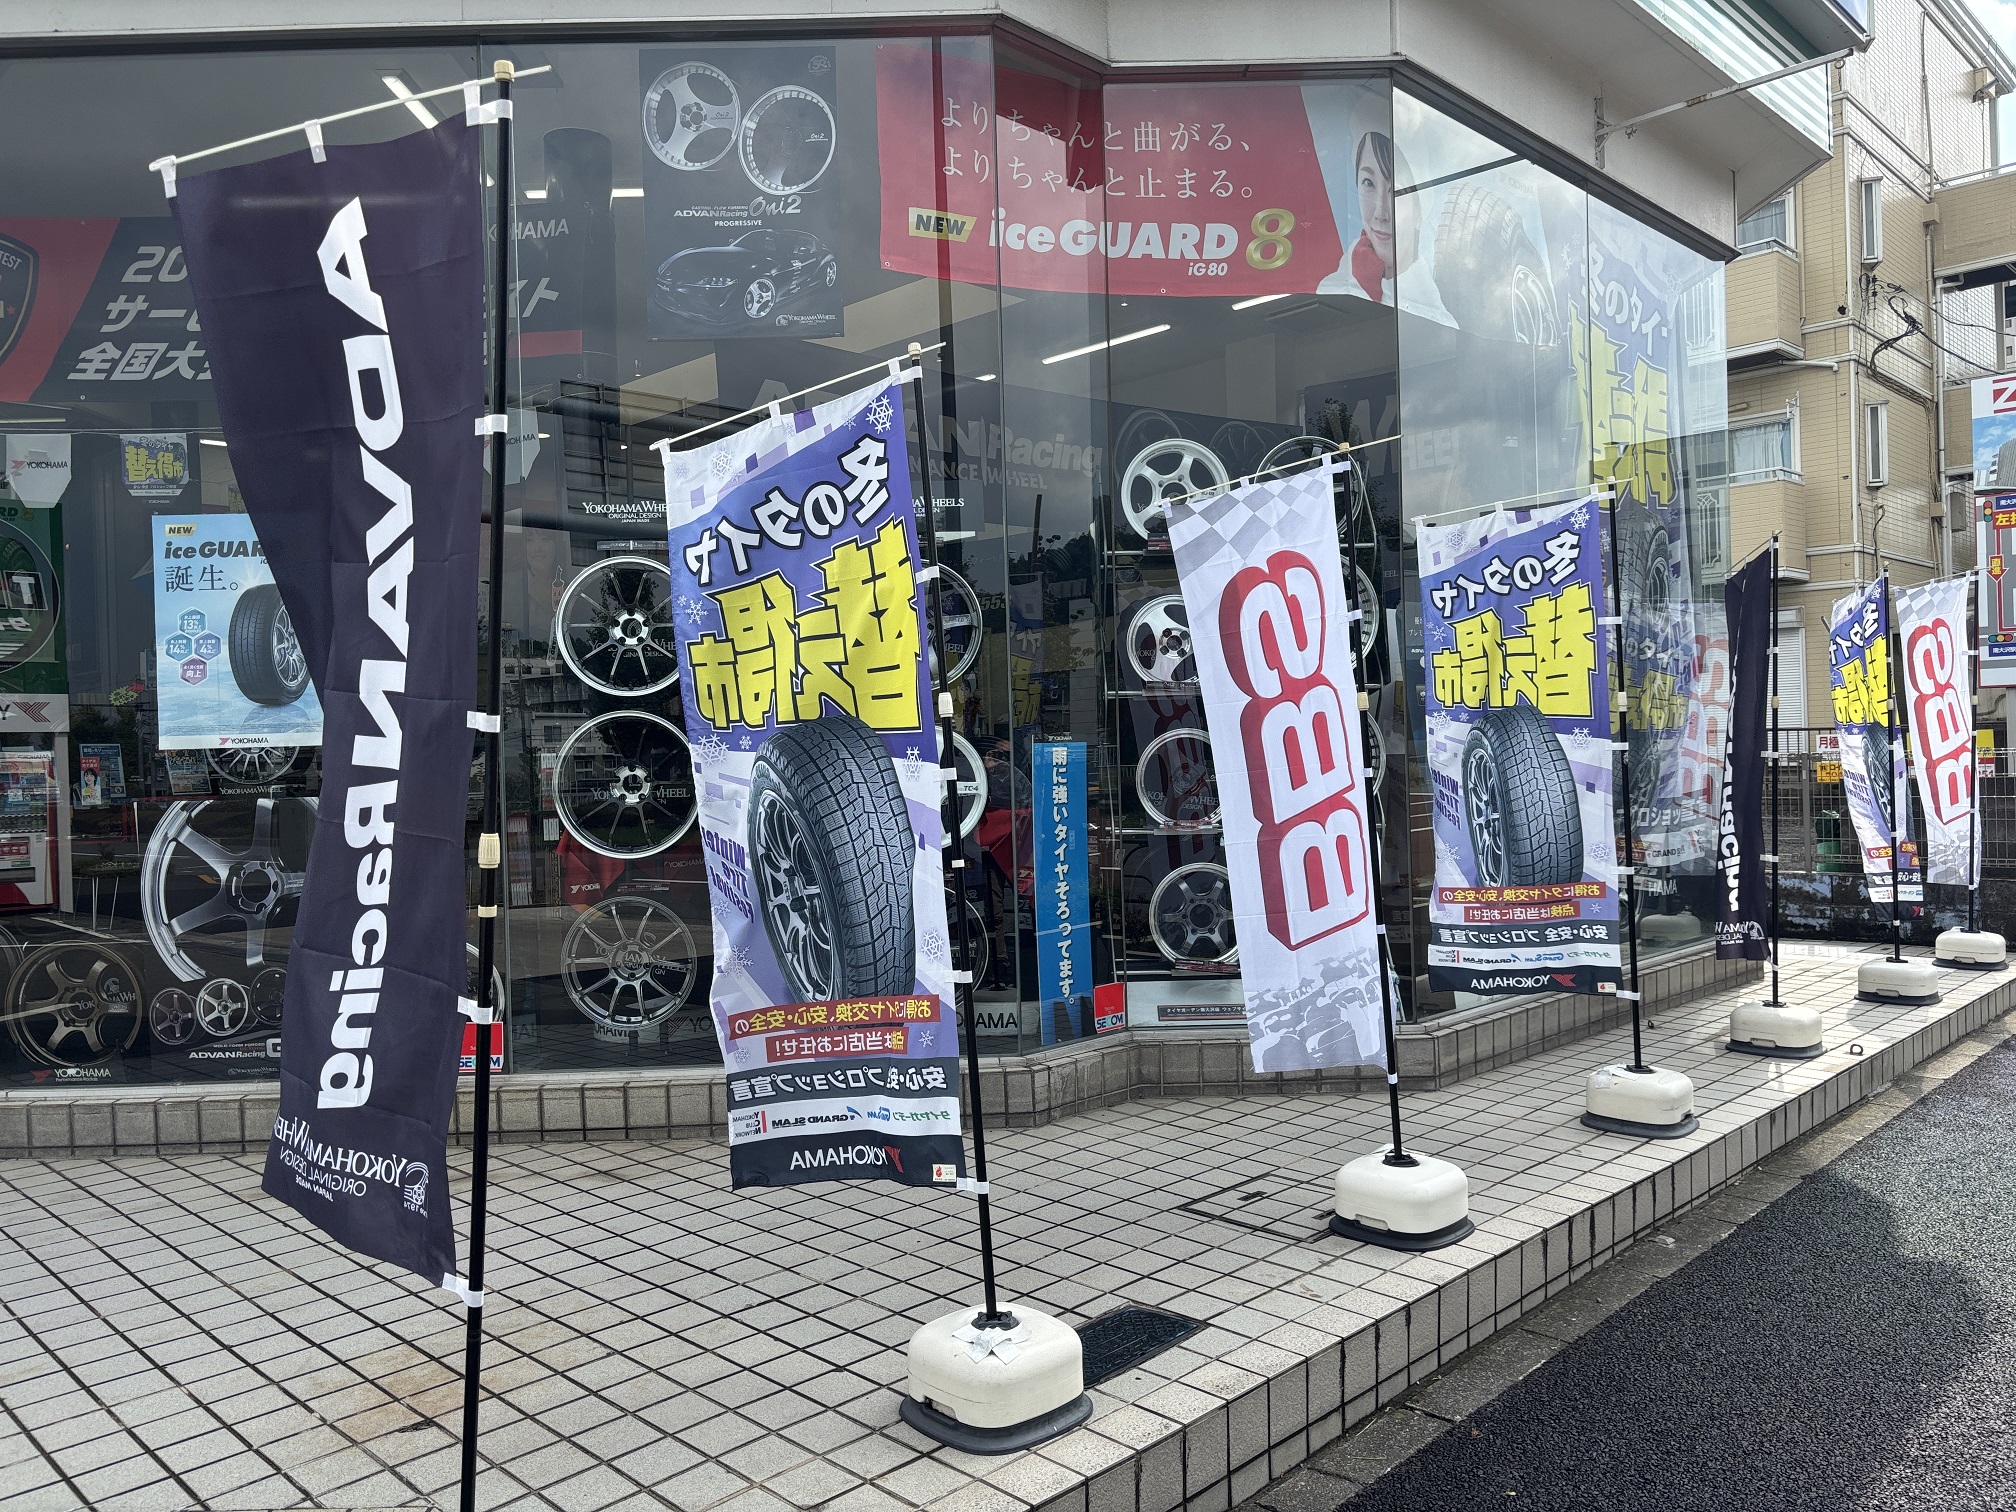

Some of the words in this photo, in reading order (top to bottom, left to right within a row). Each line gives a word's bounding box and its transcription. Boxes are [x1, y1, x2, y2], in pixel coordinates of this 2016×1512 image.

[941, 97, 1250, 152] よりちゃんと曲がる、
[941, 145, 1253, 199] よりちゃんと止まる。
[915, 214, 966, 236] NEW
[988, 207, 1238, 261] iceGUARD
[1245, 208, 1296, 270] 8
[1188, 262, 1228, 276] iG80
[26, 460, 68, 470] YOKOHAMA
[168, 526, 192, 534] NEW
[164, 564, 239, 593] 誕生。
[230, 736, 270, 746] YOKOHAMA
[1052, 745, 1075, 1006] 雨に強いタイヤそろってます。
[1096, 1013, 1124, 1030] SECOM
